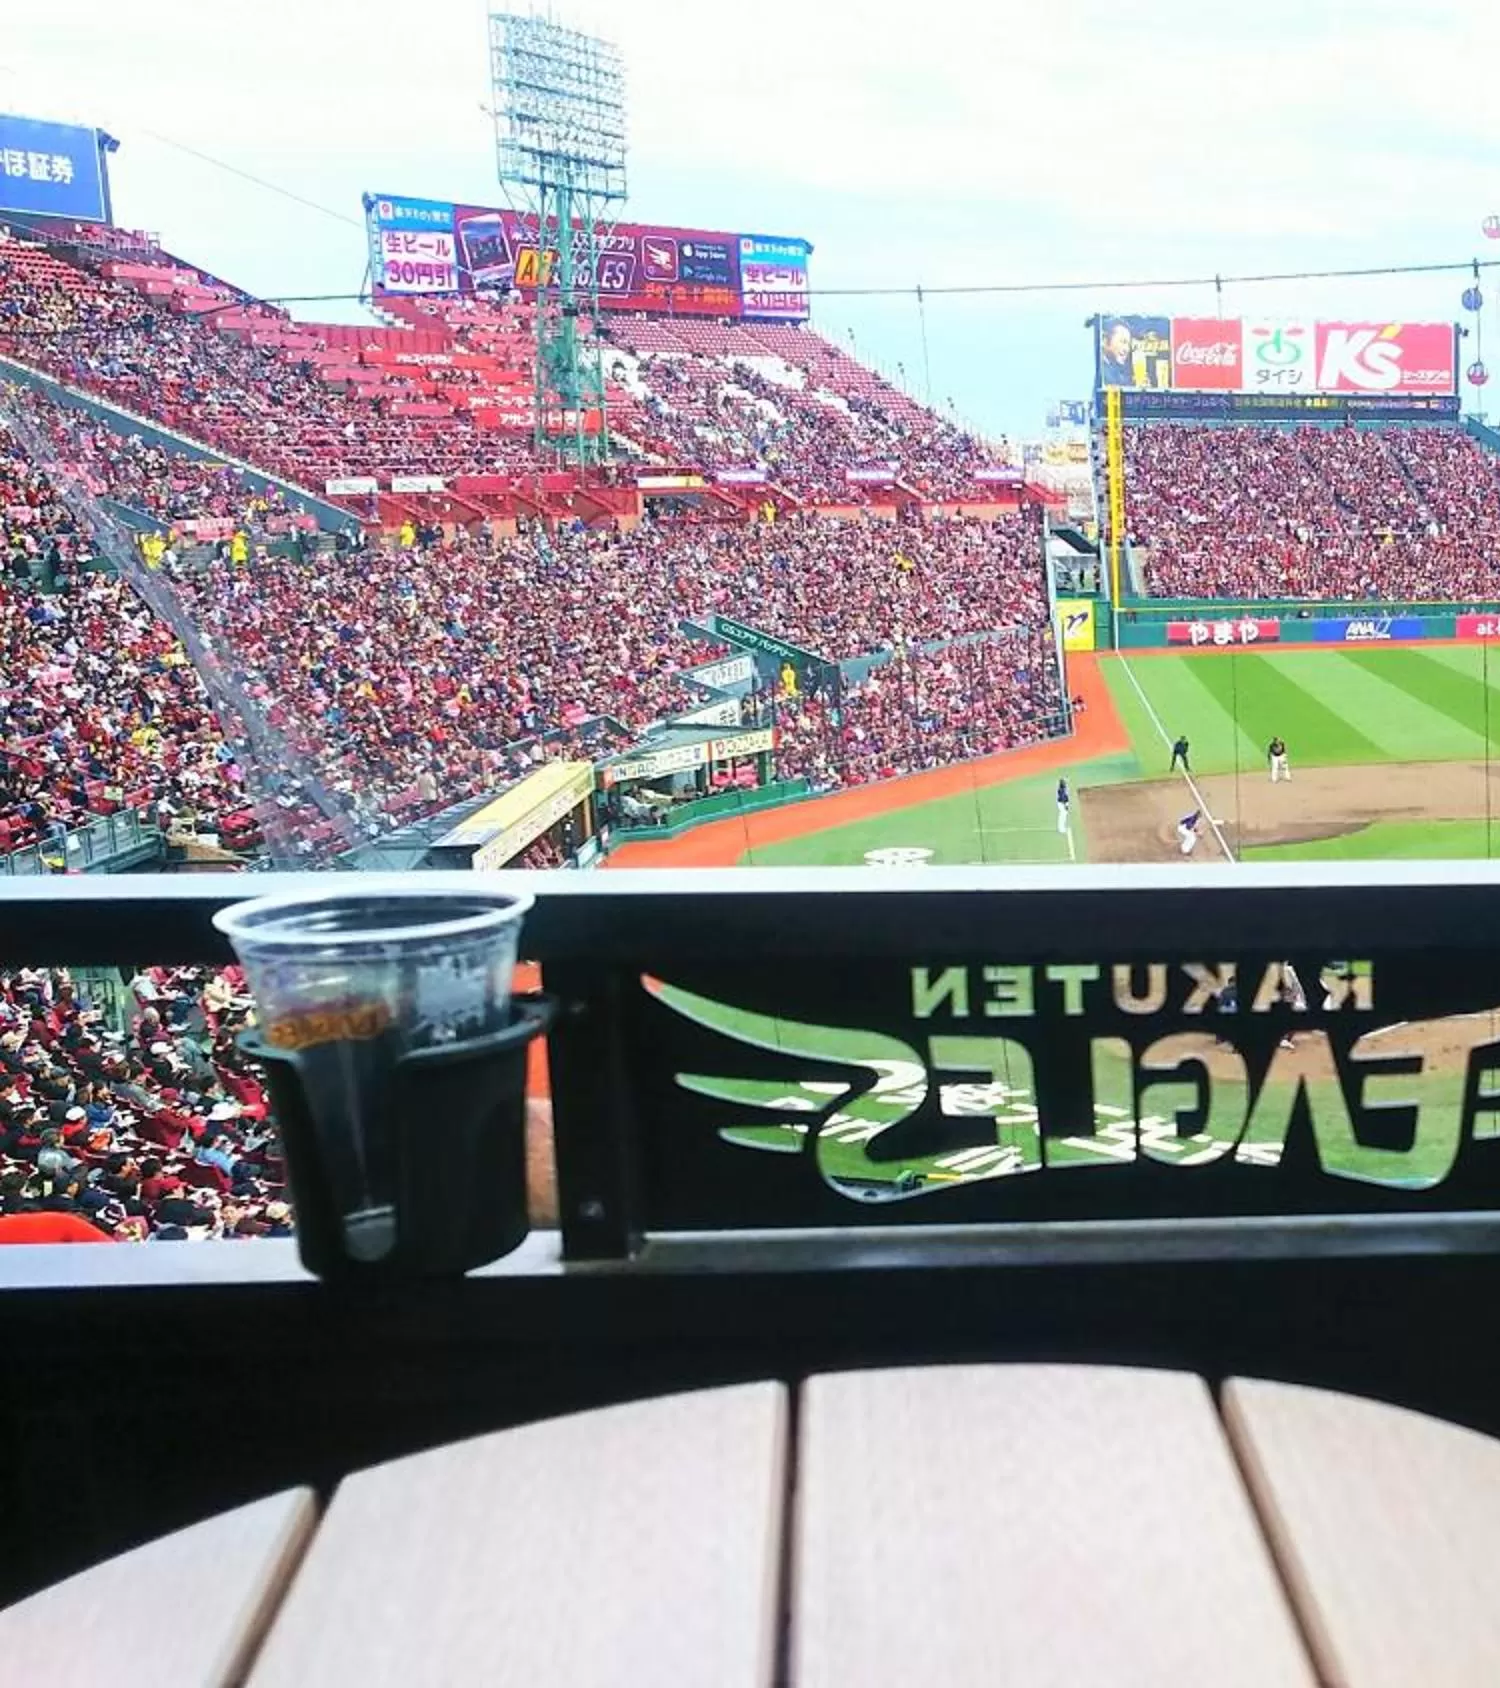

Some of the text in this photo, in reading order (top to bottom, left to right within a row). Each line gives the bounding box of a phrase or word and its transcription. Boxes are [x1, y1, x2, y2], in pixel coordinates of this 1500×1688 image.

[0, 148, 74, 184] ほ証券
[386, 233, 450, 256] 生ビール
[1188, 622, 1259, 646] やまや
[1347, 621, 1376, 636] ANA
